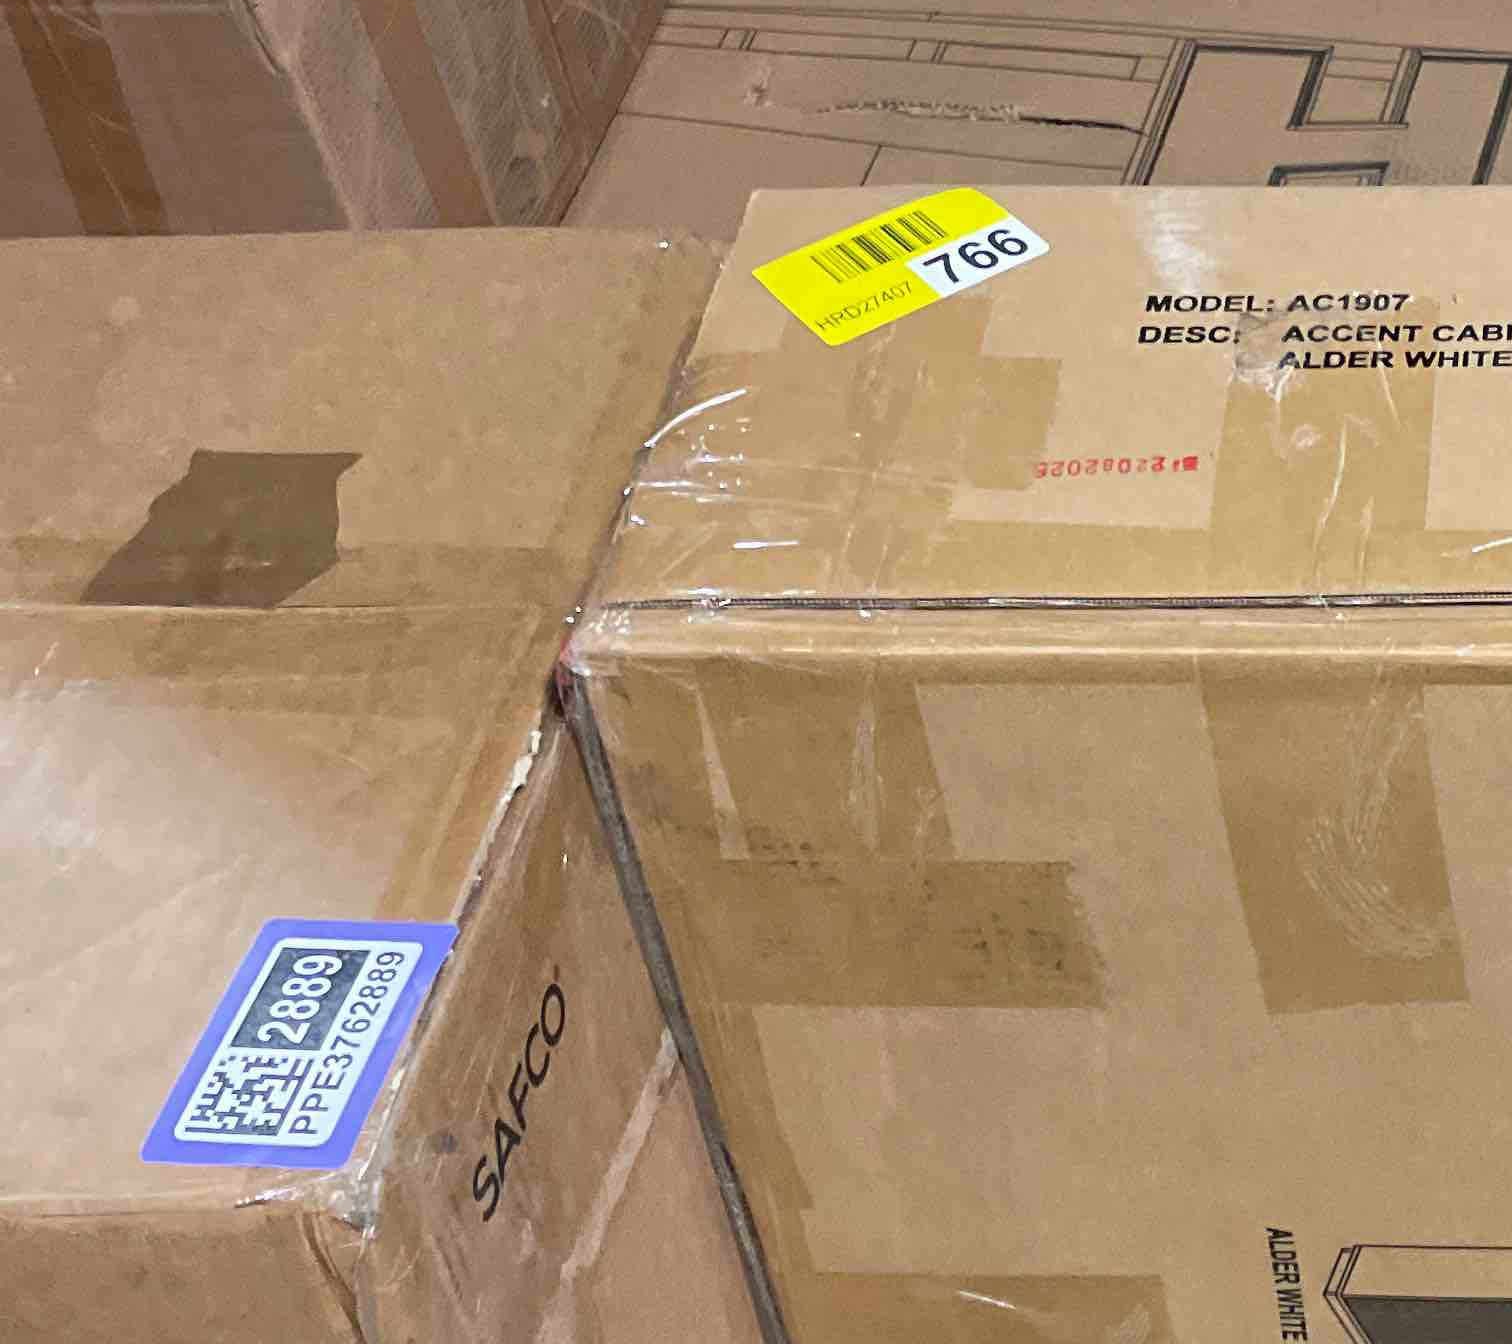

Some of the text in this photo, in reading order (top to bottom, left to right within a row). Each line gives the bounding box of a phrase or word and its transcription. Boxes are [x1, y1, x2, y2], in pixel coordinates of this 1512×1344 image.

[922, 228, 1030, 285] 766
[1145, 293, 1413, 314] MODEL: AC1907
[1137, 325, 1243, 345] DESC:
[1281, 324, 1424, 343] ACCENT
[1276, 350, 1395, 370] ALDER
[256, 953, 344, 1045] 2889
[287, 950, 406, 1136] PPE3762889
[472, 982, 567, 1223] SAFCO
[1265, 1226, 1300, 1285] ALDER
[1275, 1287, 1309, 1343] WHITE
